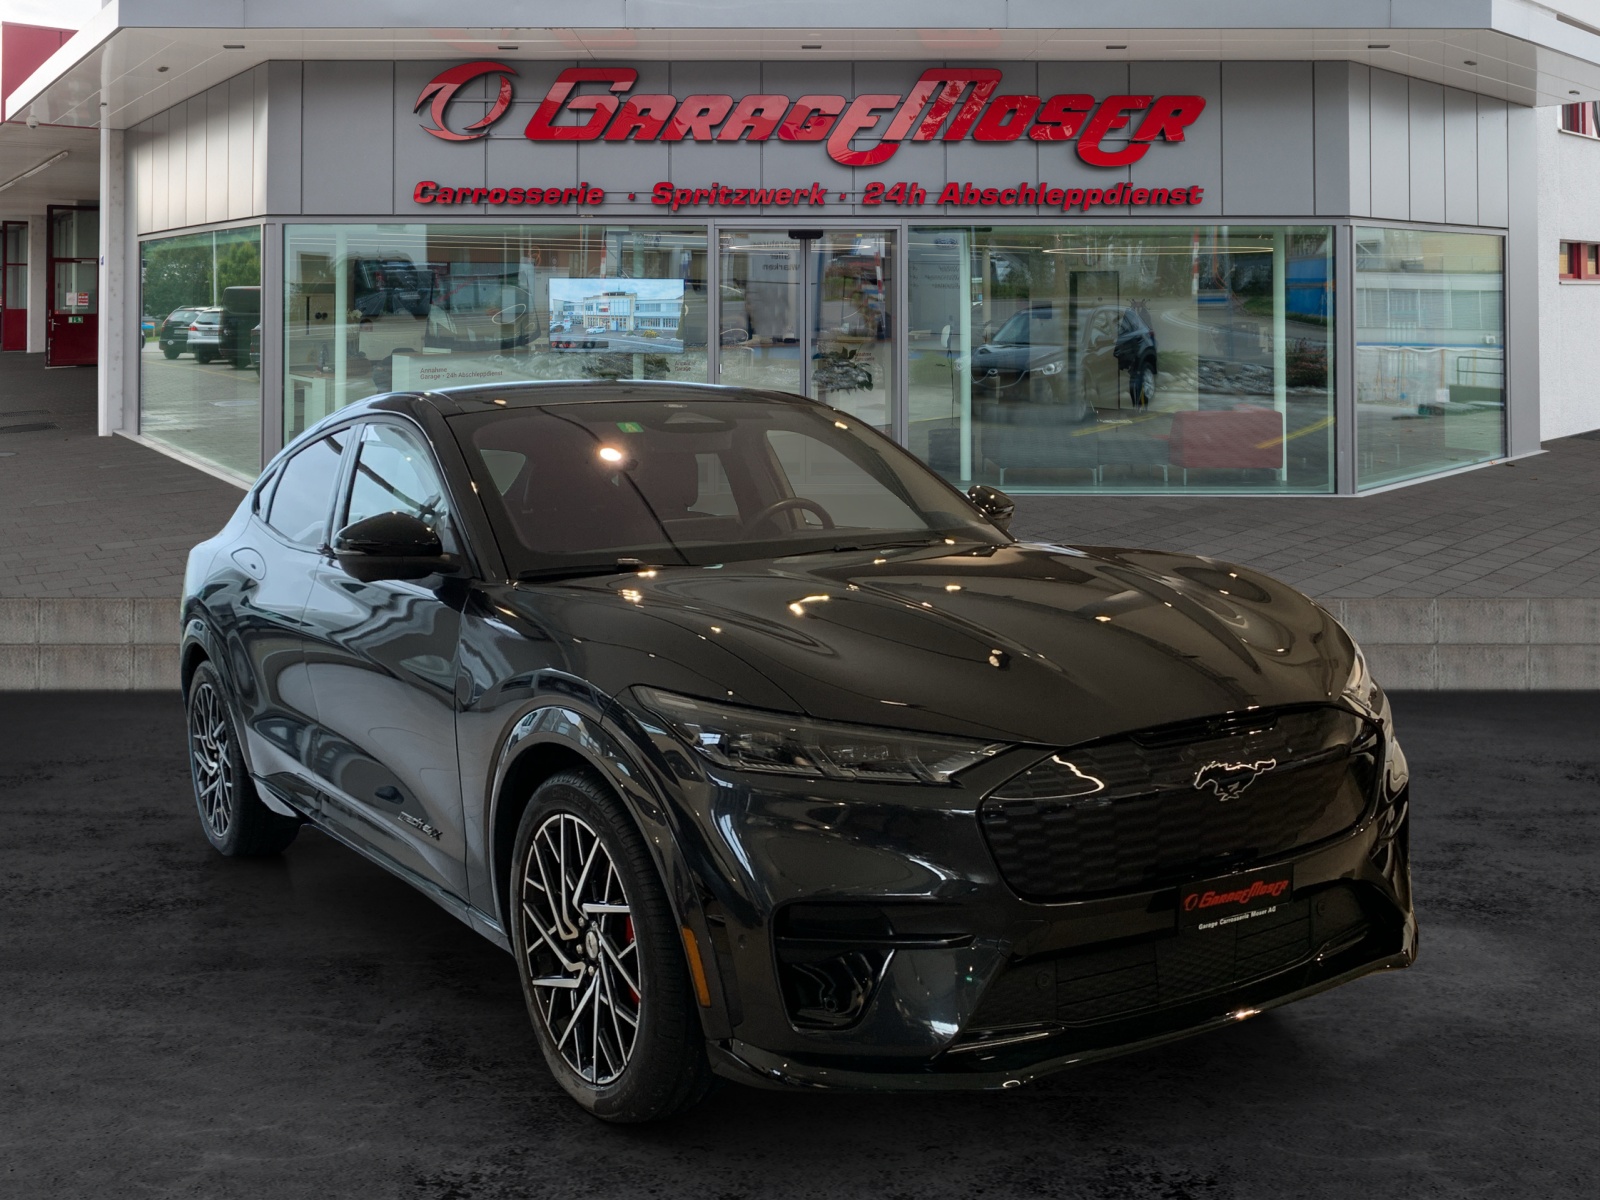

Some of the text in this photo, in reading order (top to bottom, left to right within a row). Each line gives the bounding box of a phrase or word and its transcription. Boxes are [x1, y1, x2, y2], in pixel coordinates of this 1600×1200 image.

[413, 180, 1204, 212] Carrosserie Spritzwerk 24h Abschleppdienst
[458, 370, 503, 379] Abschleppdienst
[1198, 919, 1218, 930] Garage
